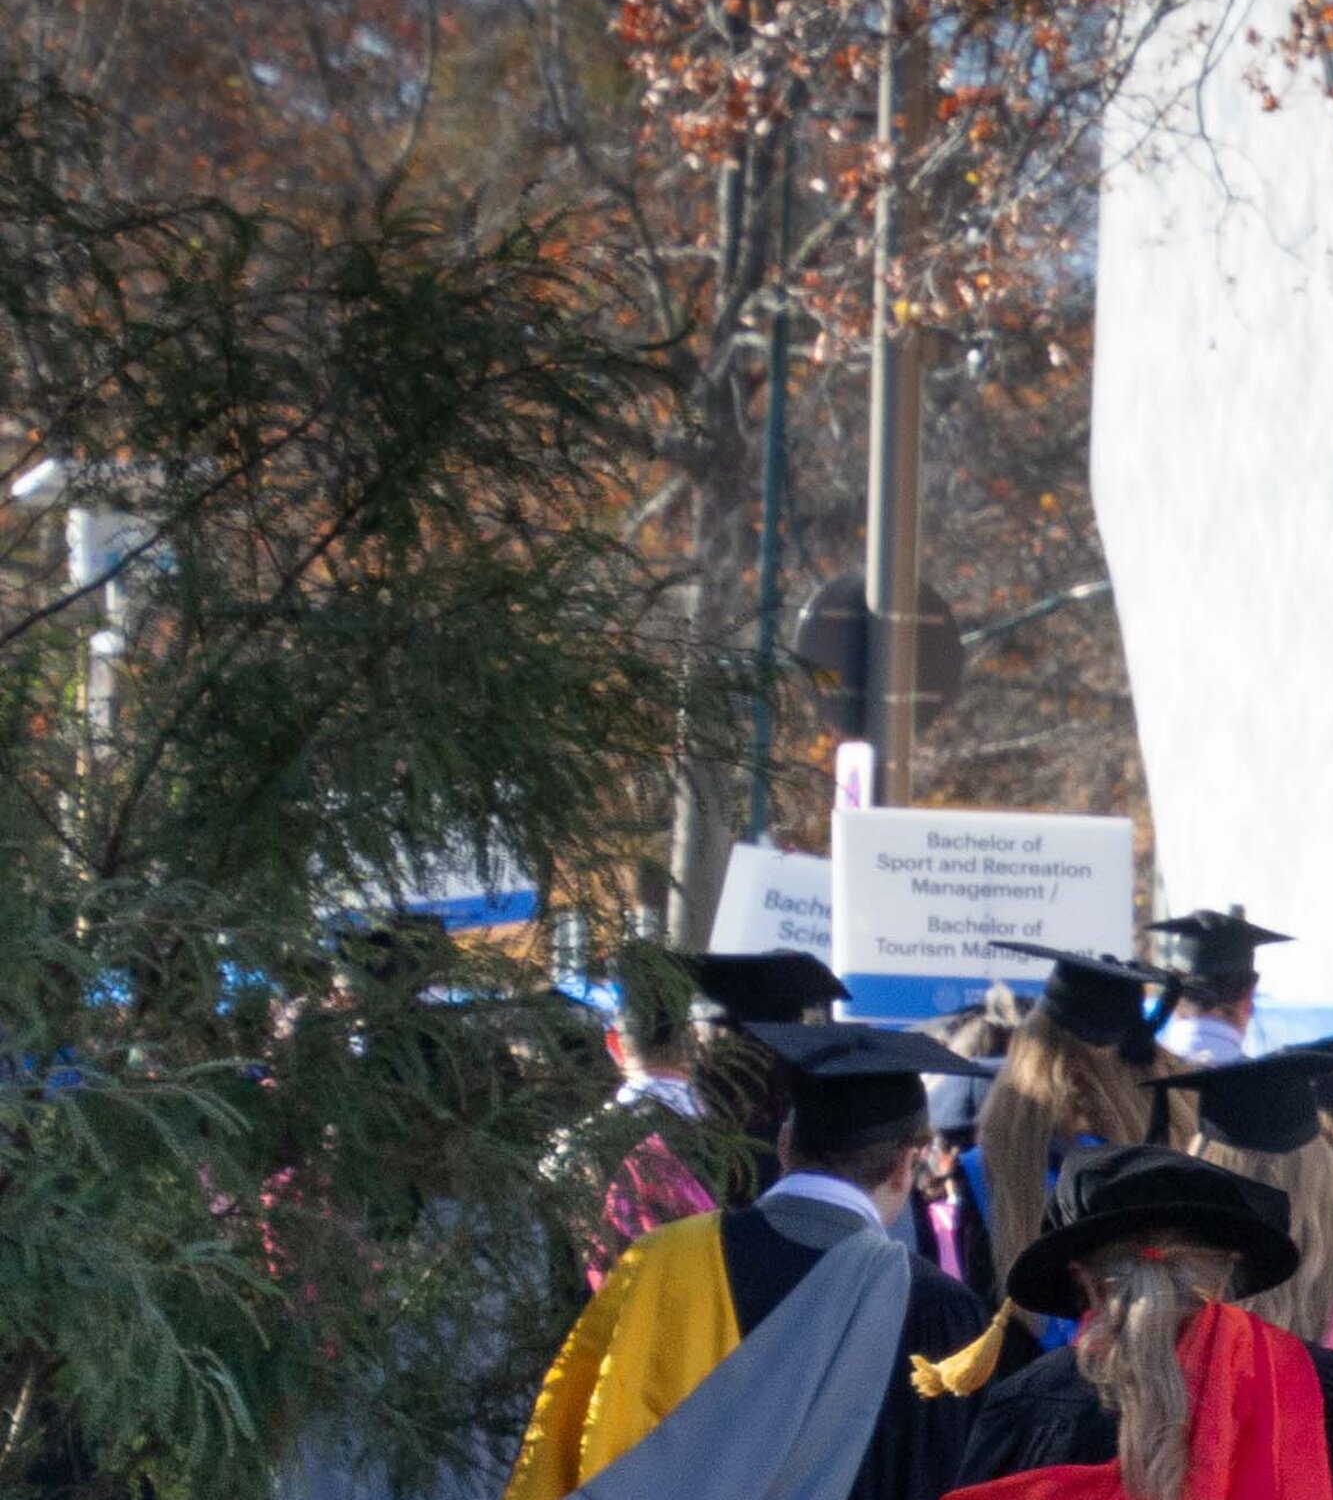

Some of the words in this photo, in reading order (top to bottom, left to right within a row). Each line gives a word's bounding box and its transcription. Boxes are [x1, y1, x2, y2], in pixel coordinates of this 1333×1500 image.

[928, 832, 1014, 852] Bachelor
[1021, 834, 1042, 853] of
[877, 854, 932, 874] Sport
[939, 857, 976, 873] and
[983, 857, 1092, 878] Recreation
[911, 878, 1043, 900] Management
[928, 916, 1016, 936] Bachelor
[1023, 919, 1043, 937] of
[876, 938, 954, 957] Tourism
